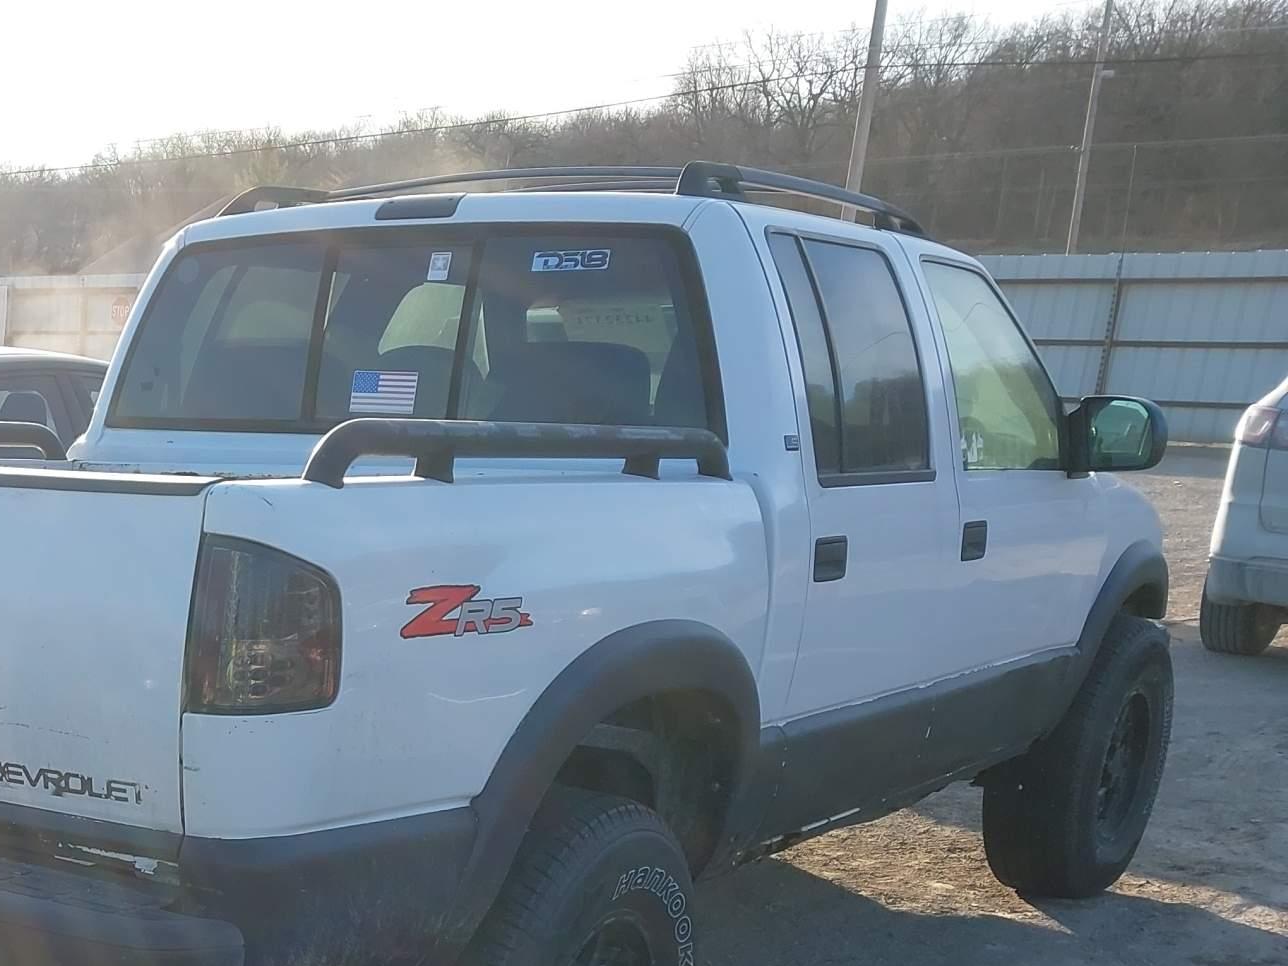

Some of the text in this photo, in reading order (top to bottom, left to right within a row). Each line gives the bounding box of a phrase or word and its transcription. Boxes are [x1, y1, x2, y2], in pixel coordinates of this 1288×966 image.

[532, 249, 610, 270] DS18
[112, 304, 130, 318] STOP
[400, 584, 533, 640] ZR5
